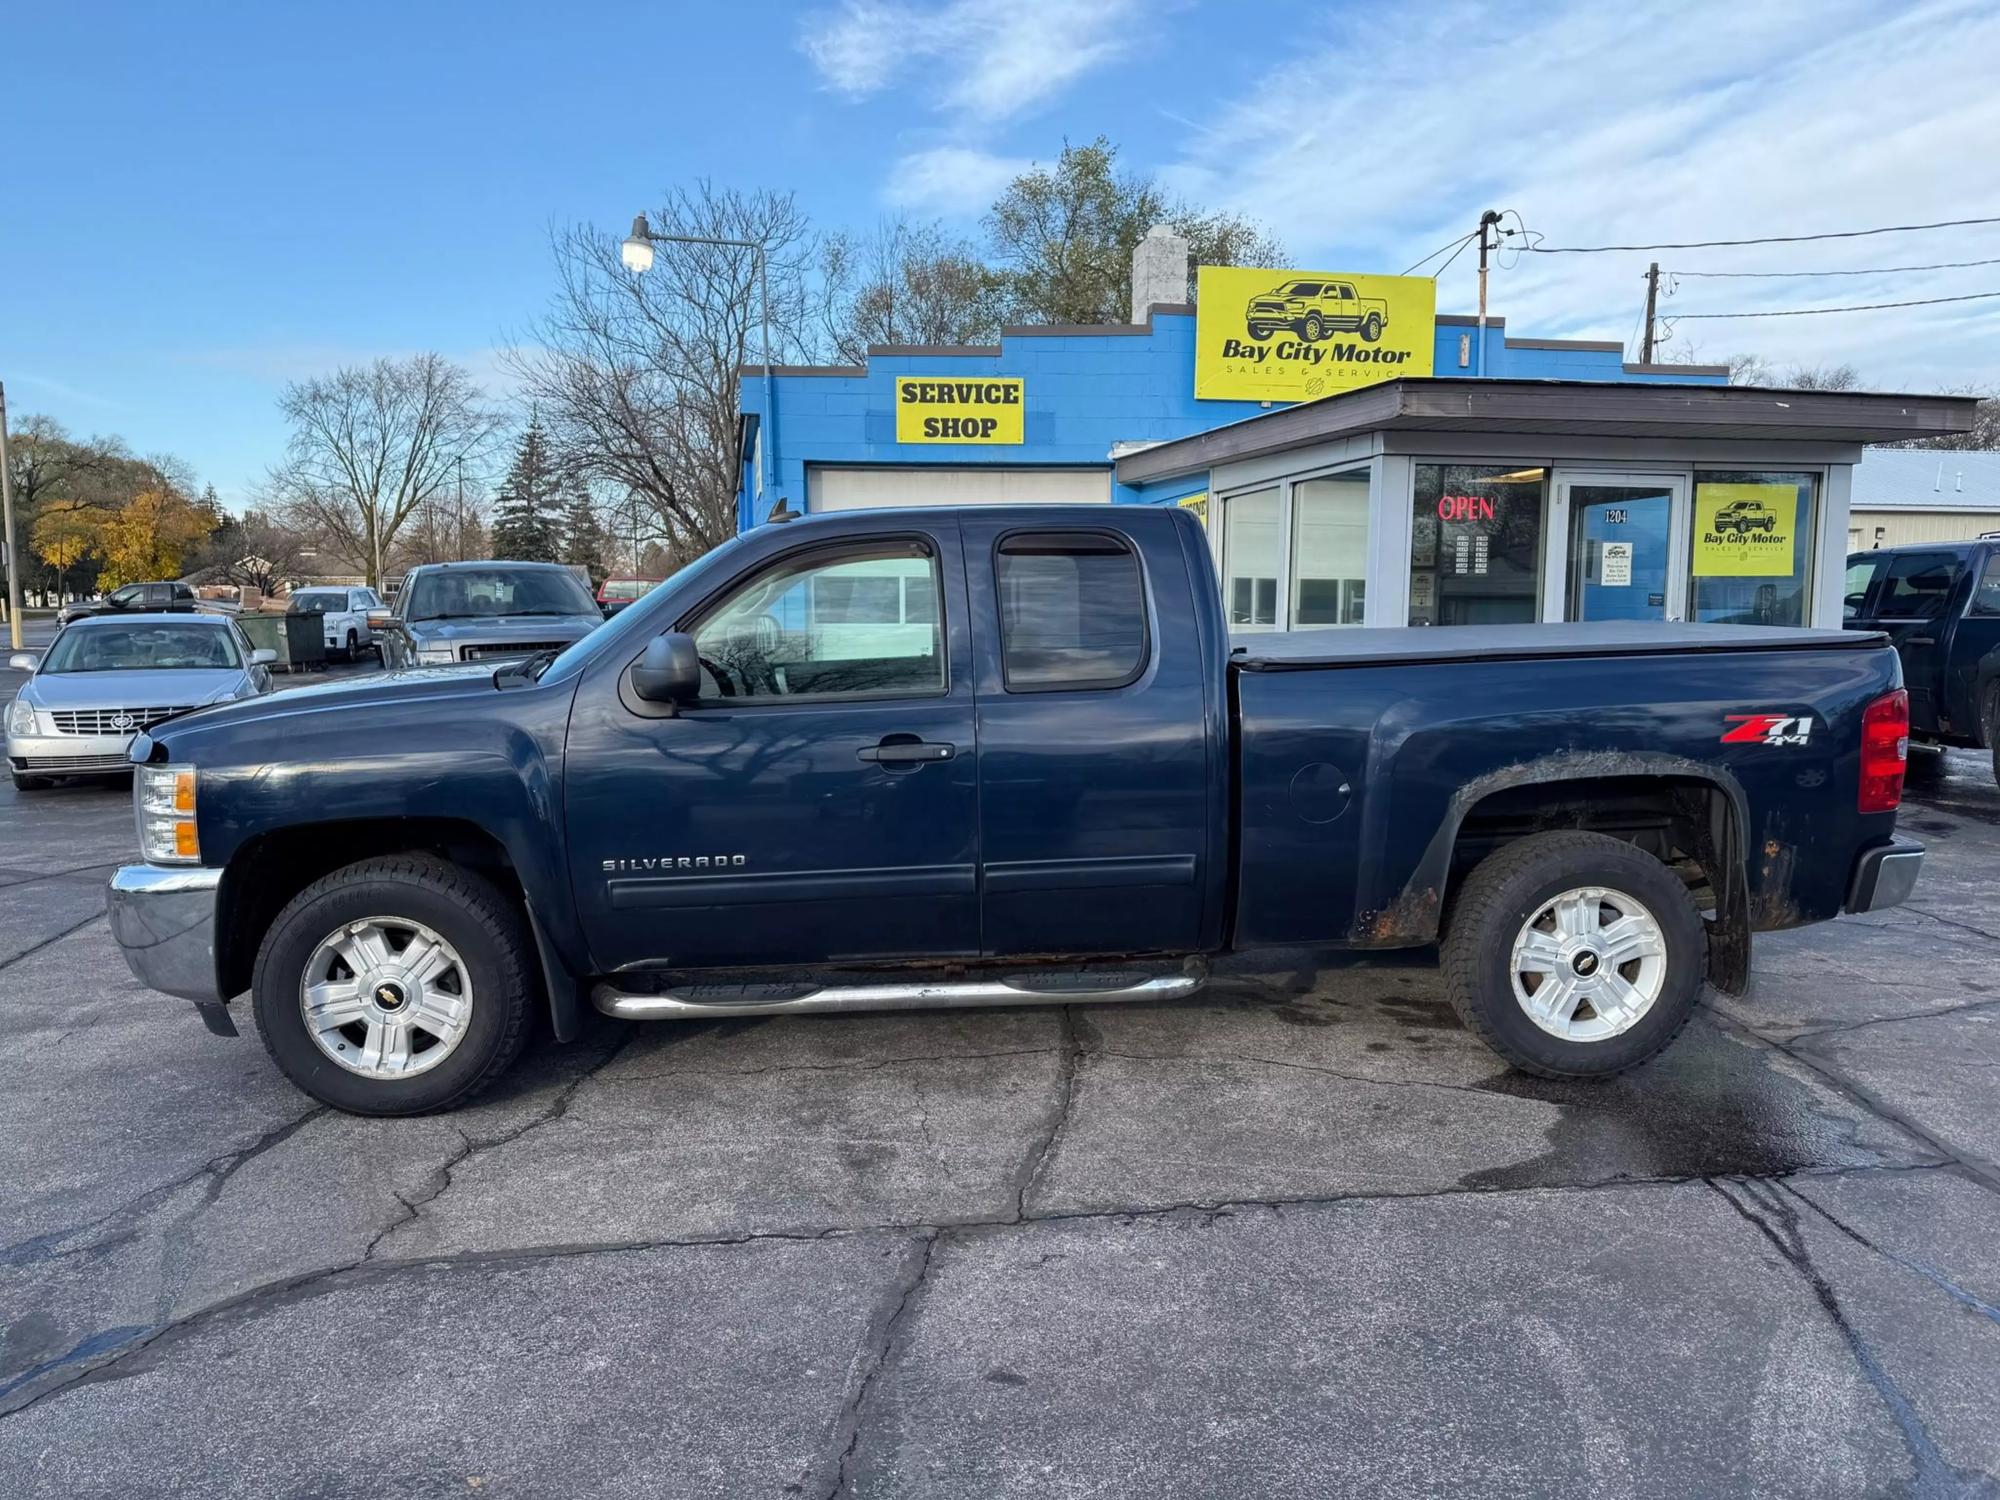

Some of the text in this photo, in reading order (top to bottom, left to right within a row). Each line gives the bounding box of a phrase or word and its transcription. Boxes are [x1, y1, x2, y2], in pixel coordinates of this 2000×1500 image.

[1222, 339, 1412, 365] Bay City Motor
[1226, 365, 1285, 375] SALES
[901, 382, 1020, 404] SERVICE
[923, 417, 998, 438] SHOP
[1438, 496, 1494, 520] OPEN
[1606, 510, 1628, 523] 1204
[1703, 532, 1786, 546] Bay City Motor
[1720, 714, 1813, 743] Z71
[602, 854, 746, 871] SILVERADO
